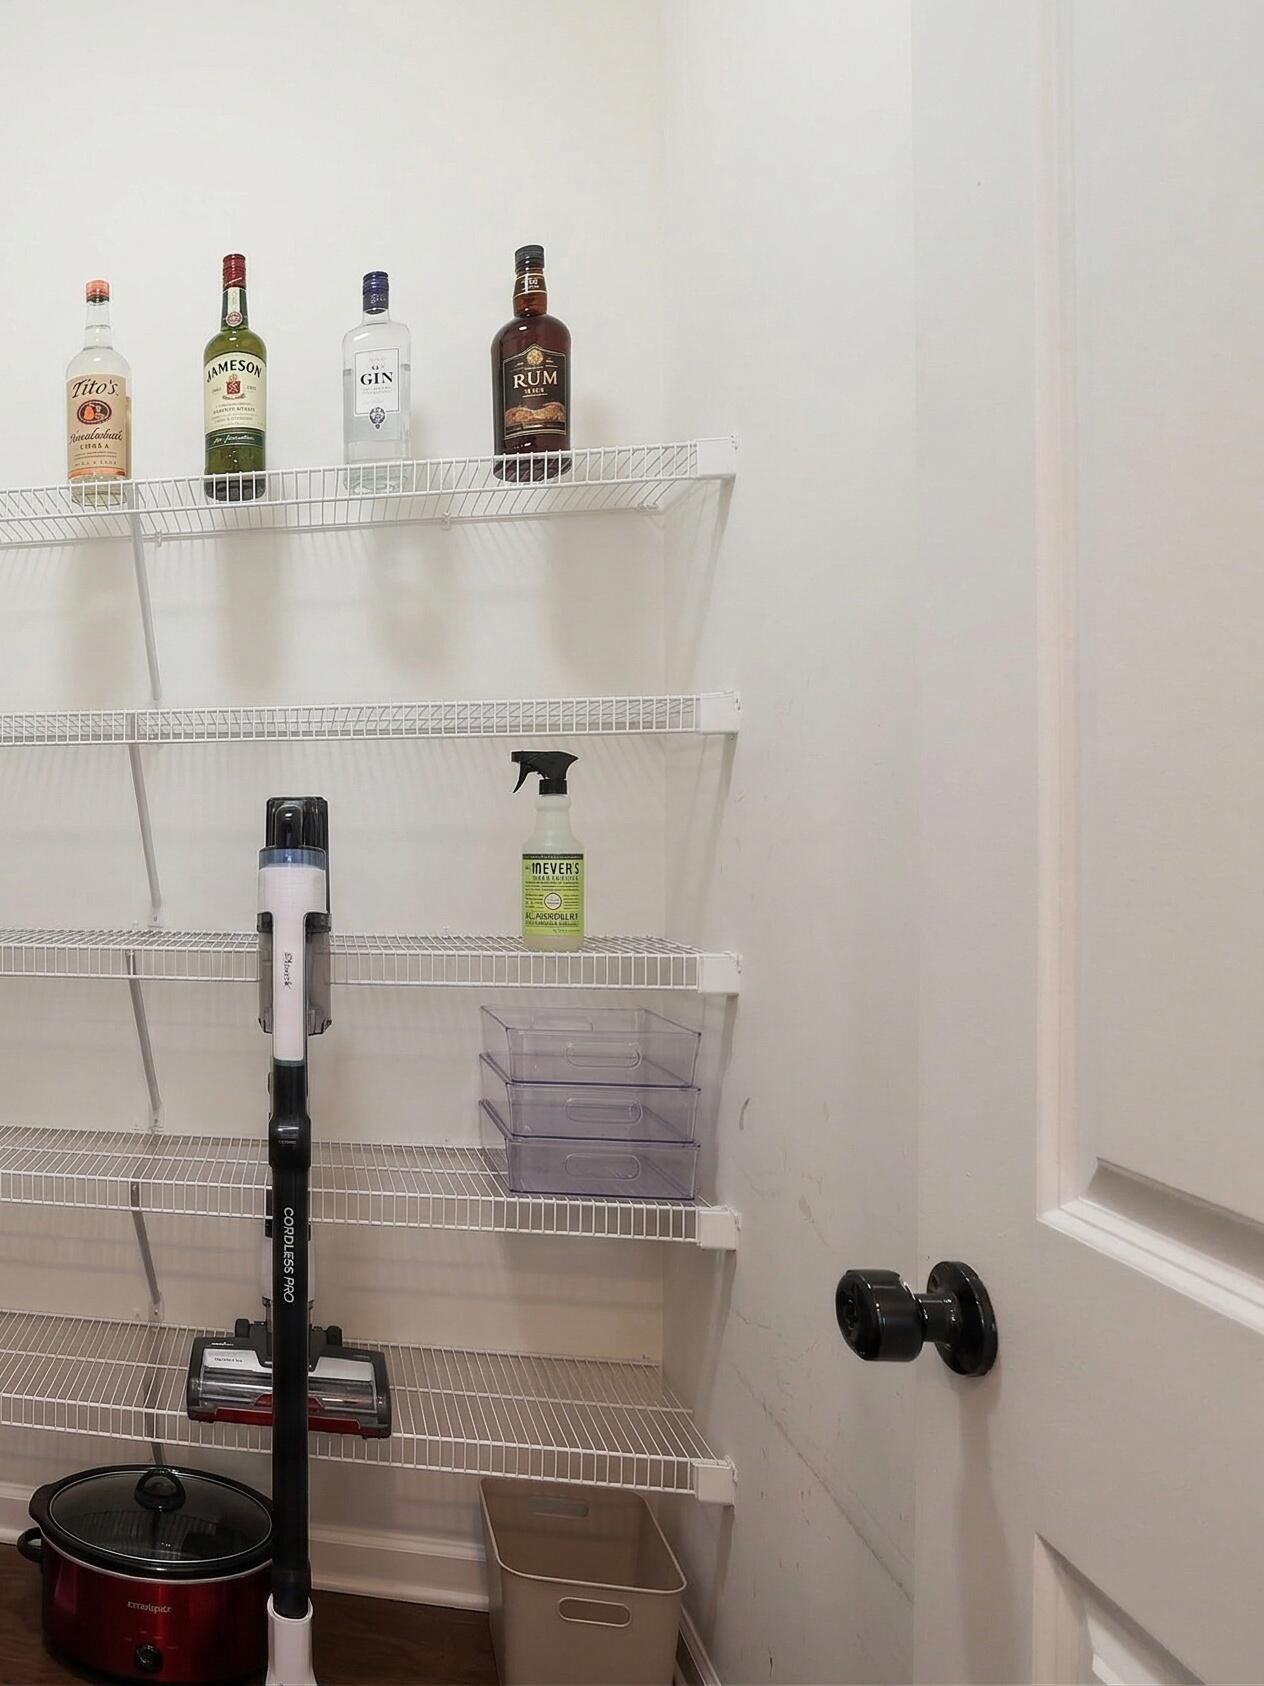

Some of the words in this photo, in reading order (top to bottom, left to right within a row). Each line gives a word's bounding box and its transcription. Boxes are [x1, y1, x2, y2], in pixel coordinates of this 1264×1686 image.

[206, 359, 262, 383] JAMESON
[360, 371, 393, 385] GIN
[513, 370, 558, 389] RUM
[72, 378, 118, 399] Tito's
[283, 1207, 295, 1274] CORDLESS
[283, 1276, 295, 1303] PRO
